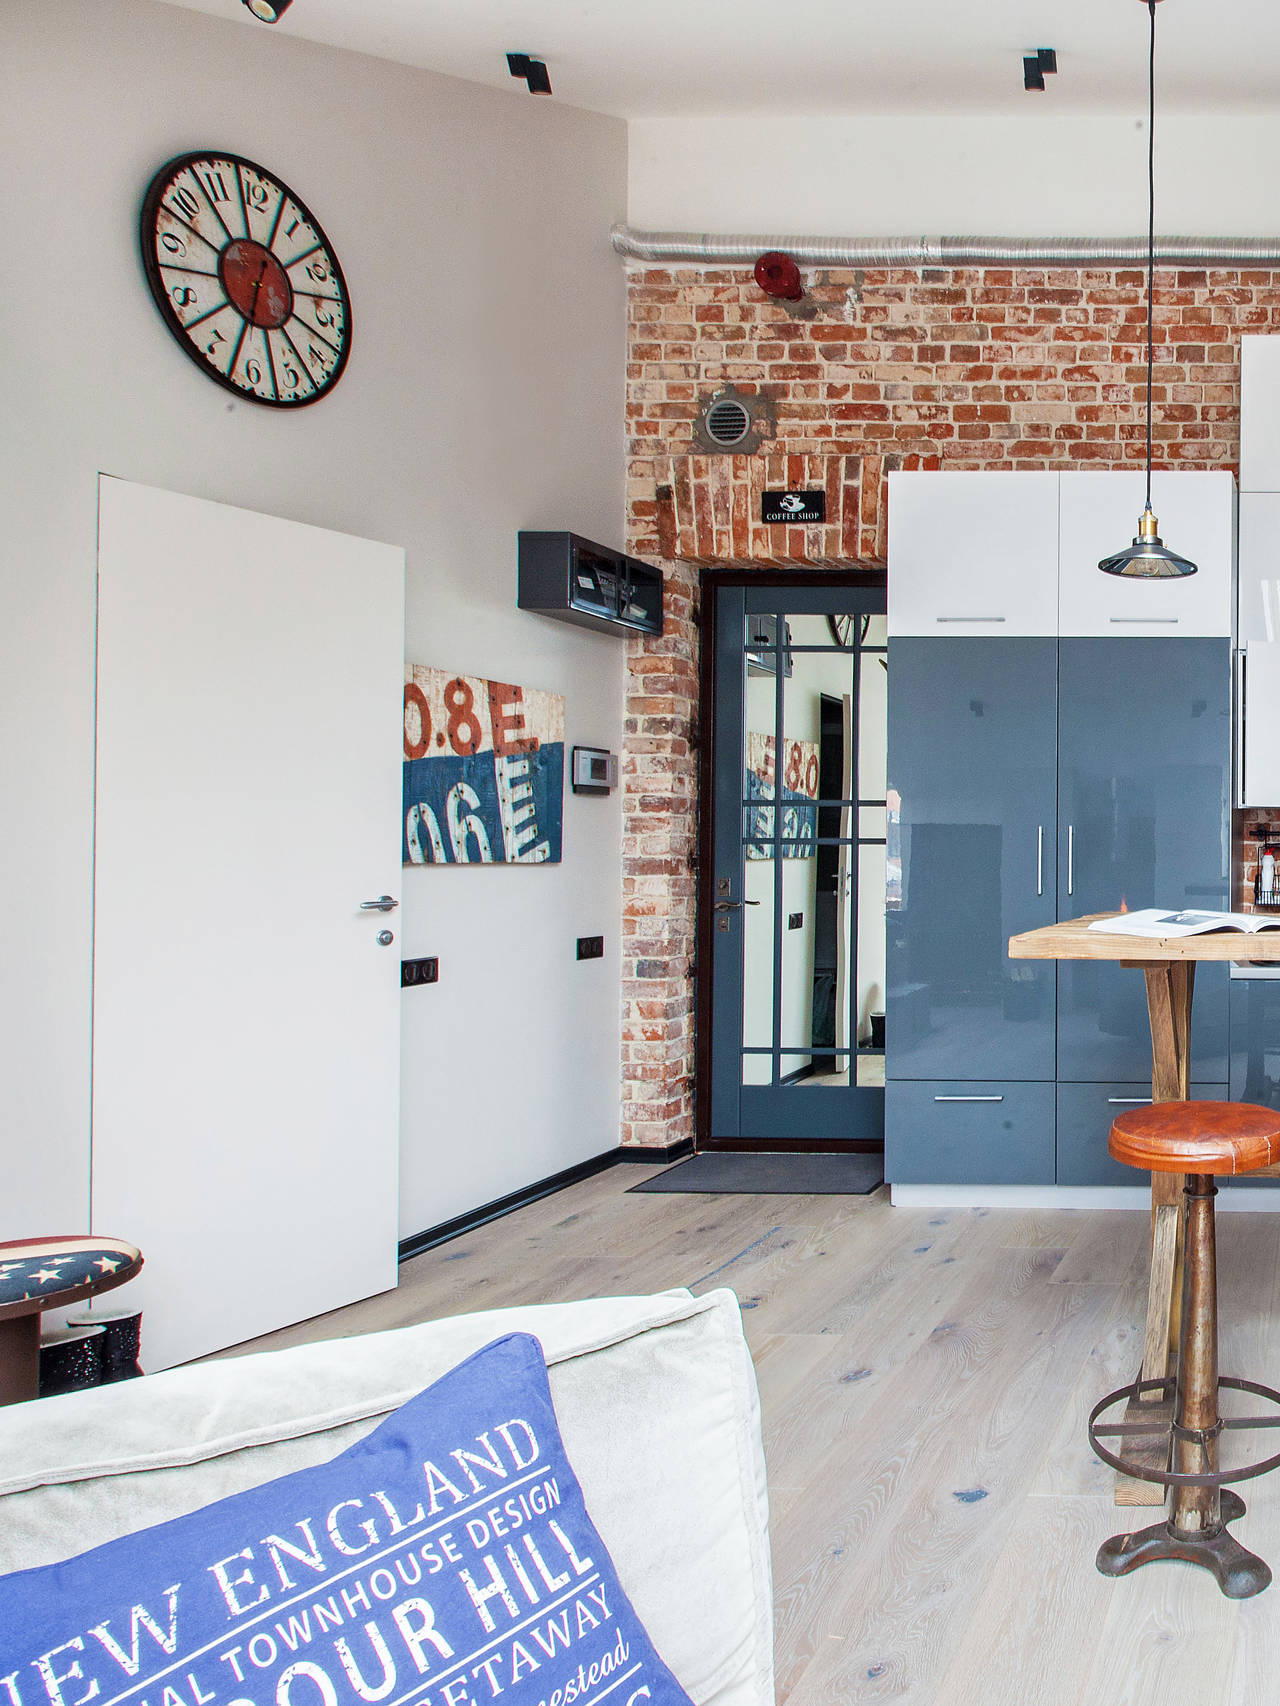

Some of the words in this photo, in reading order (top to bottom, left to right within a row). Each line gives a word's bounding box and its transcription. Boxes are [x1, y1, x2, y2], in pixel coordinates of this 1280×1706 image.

[205, 172, 231, 202] 11
[245, 180, 269, 214] 12
[171, 187, 200, 221] 10
[284, 219, 300, 241] 1
[161, 232, 186, 258] 9
[305, 263, 327, 283] 2
[172, 286, 198, 308] 8
[315, 307, 335, 329] 3
[207, 329, 228, 355] 7
[308, 344, 328, 366] 4
[245, 358, 261, 385] 6
[282, 362, 300, 389] 5
[766, 512, 796, 520] COFFEE
[797, 512, 820, 520] SHOP
[207, 1418, 540, 1620] ENGLAND
[220, 1533, 463, 1683] TOWNHOUSE
[466, 1478, 562, 1549] DESIGN
[226, 1597, 456, 1706] OUR
[458, 1519, 594, 1634] HILL
[414, 1583, 613, 1706] ETAWAY
